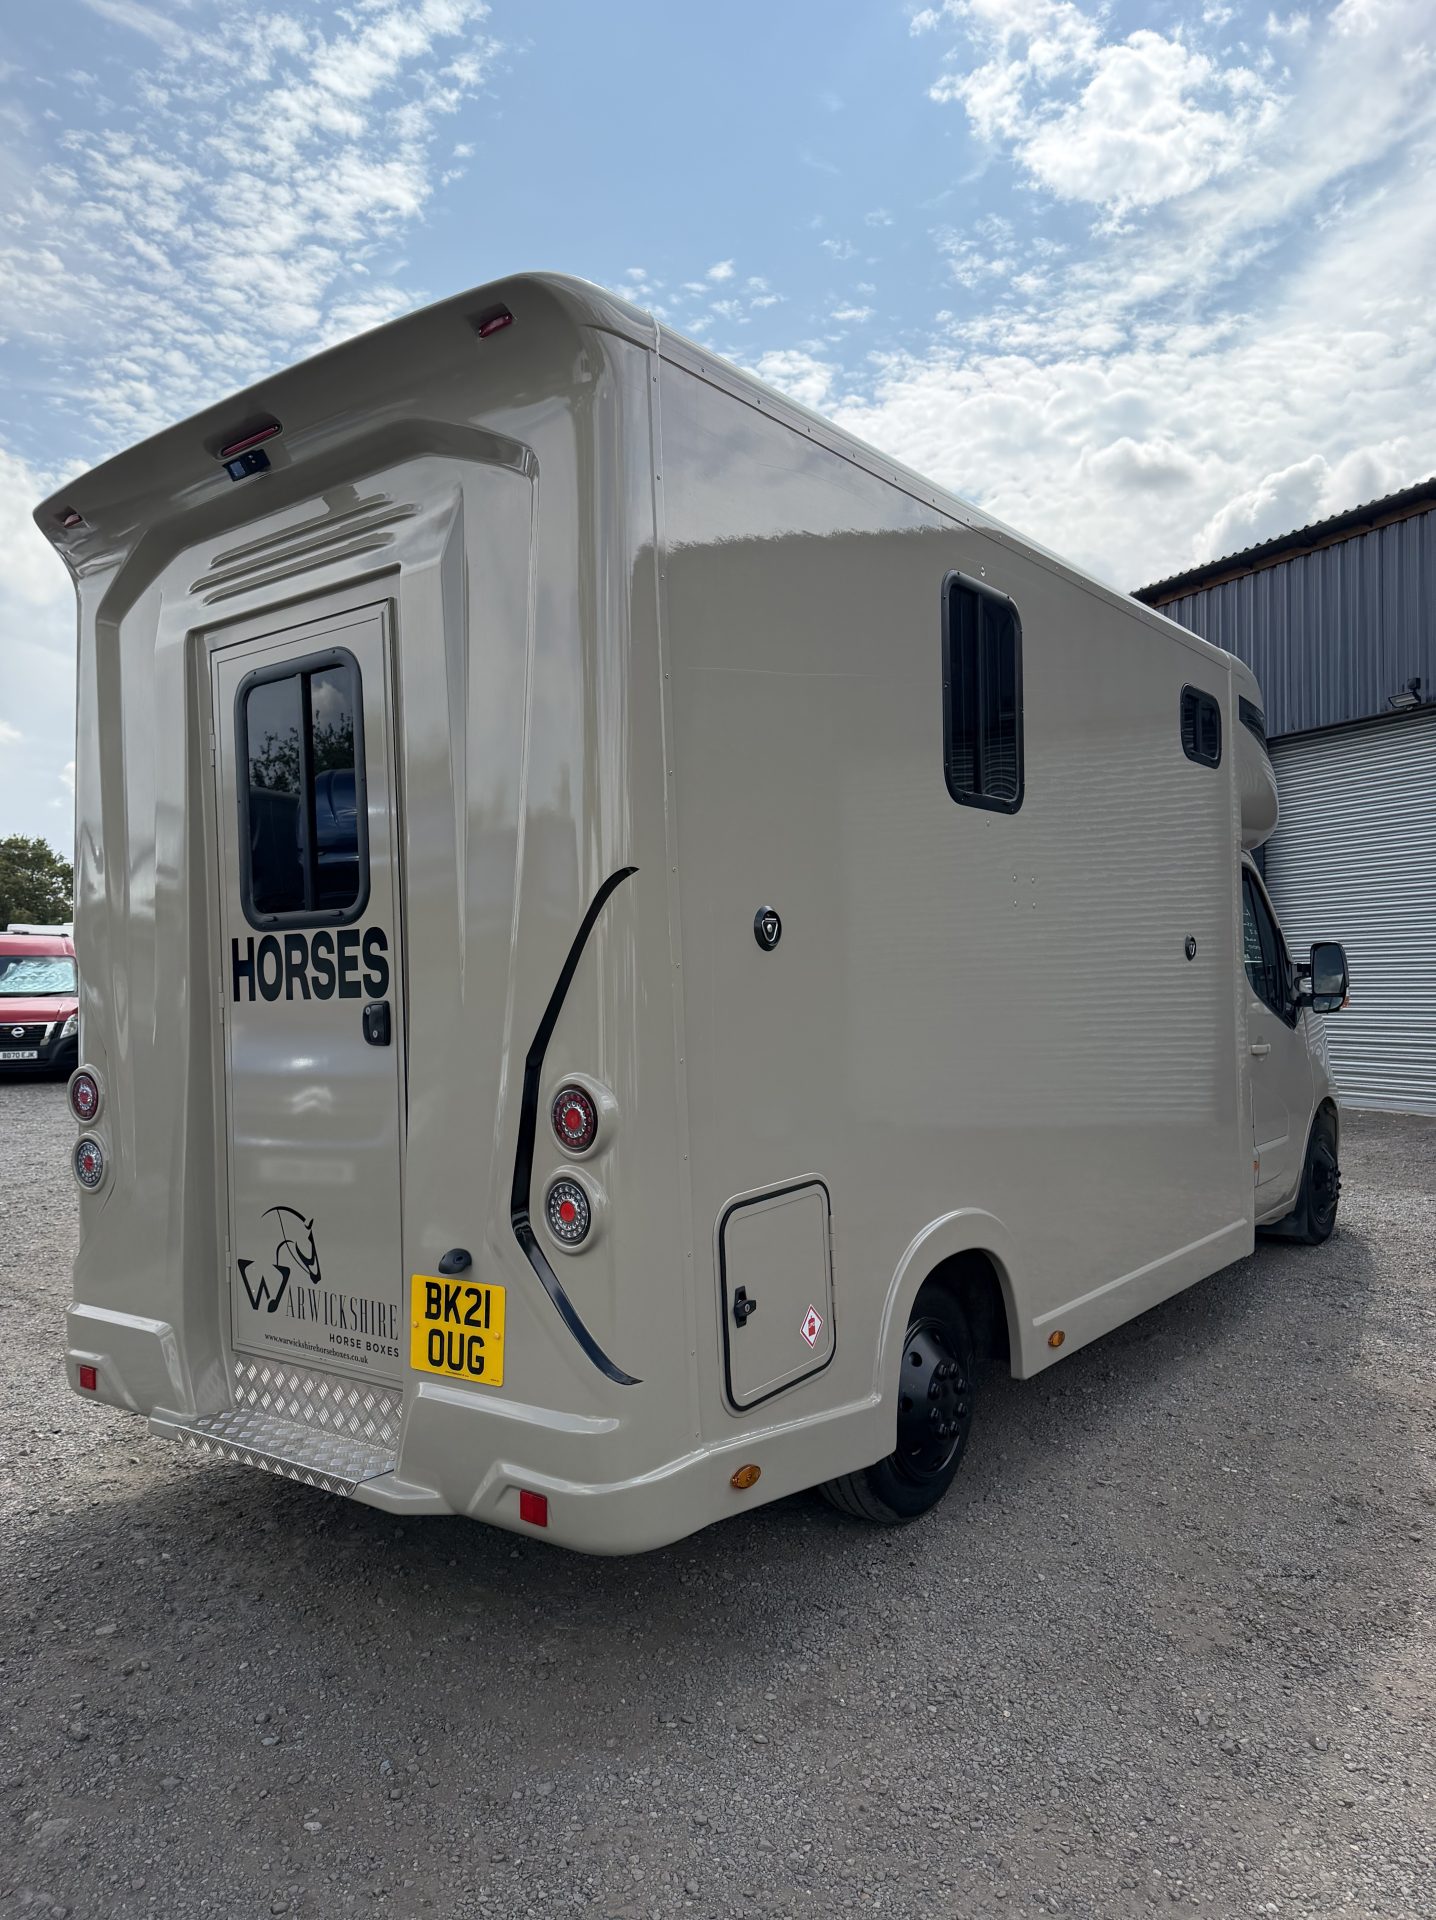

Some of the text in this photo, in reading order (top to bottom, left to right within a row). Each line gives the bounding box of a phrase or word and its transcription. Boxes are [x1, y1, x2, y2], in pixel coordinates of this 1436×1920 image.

[232, 926, 390, 1002] HORSES
[237, 1258, 399, 1341] WARWICKSHIRE
[425, 1281, 491, 1329] BK21
[264, 1332, 369, 1365] www.warwickshirehorseboxes.co.uk
[329, 1333, 399, 1358] HORSE BOXES
[428, 1328, 485, 1375] OUG
